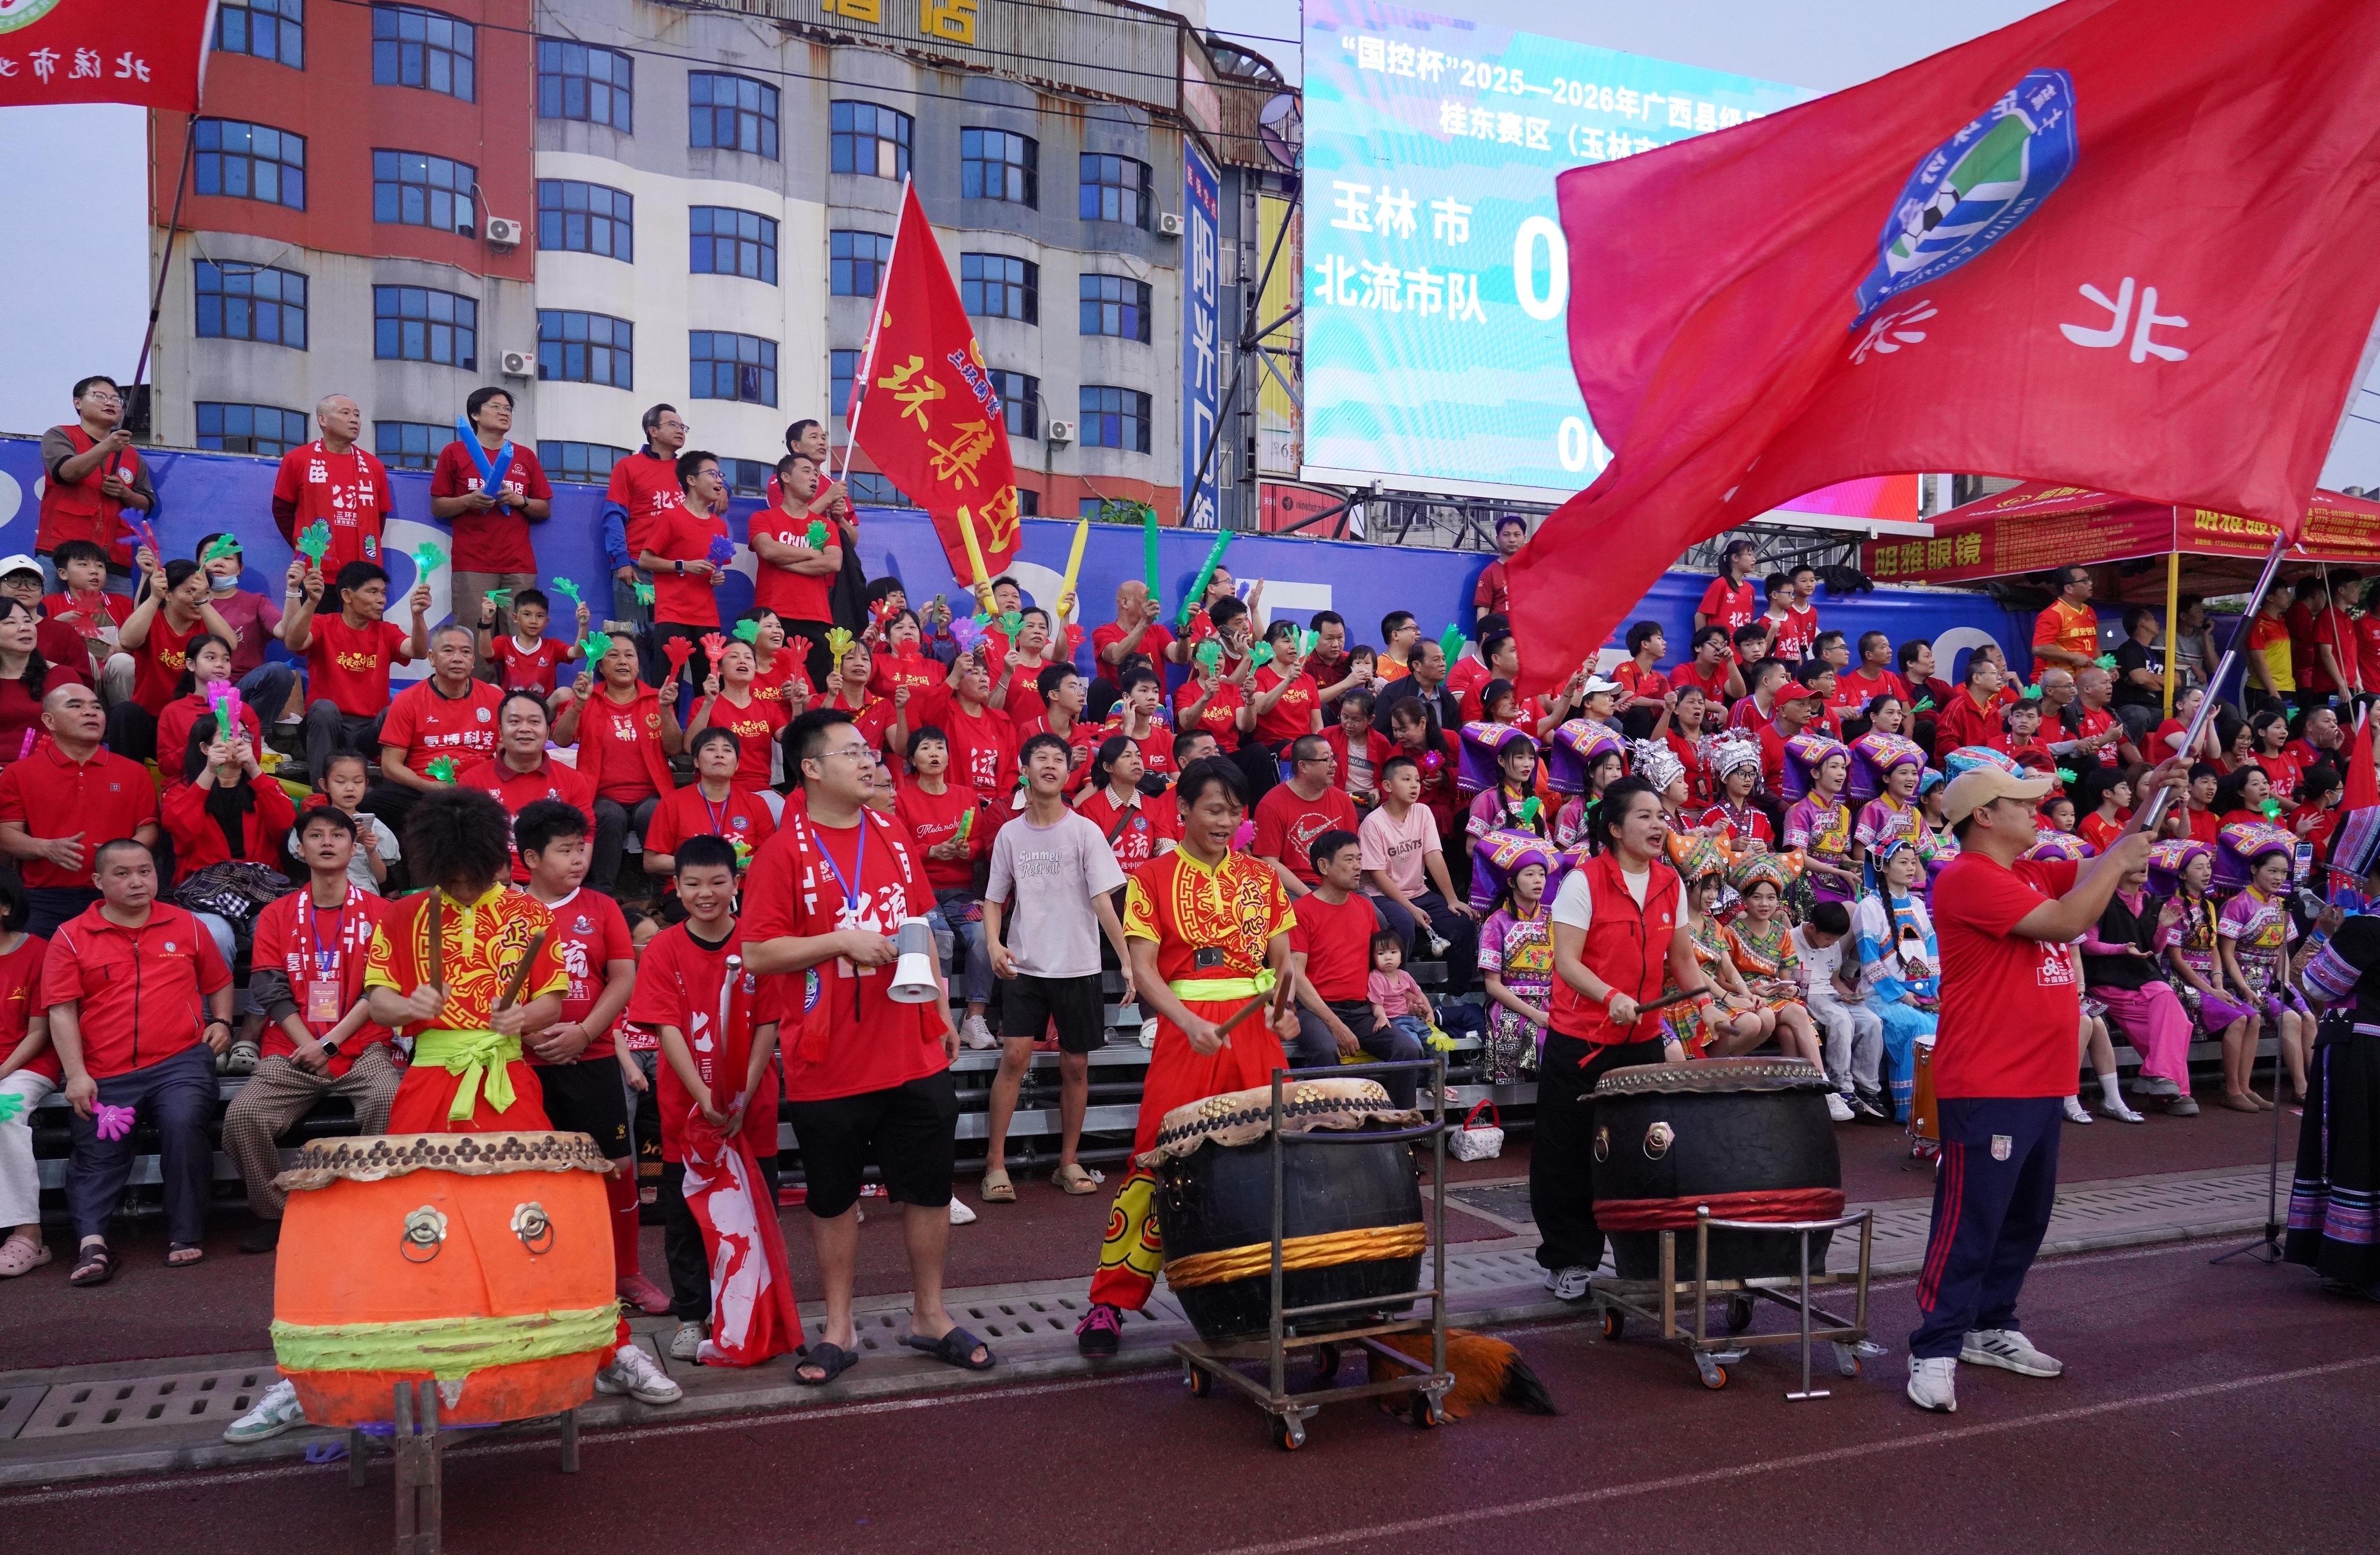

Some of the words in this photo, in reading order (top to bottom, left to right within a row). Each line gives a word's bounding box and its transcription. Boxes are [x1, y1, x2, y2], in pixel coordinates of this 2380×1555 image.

[1331, 181, 1417, 240] 玉林
[1432, 196, 1472, 247] 市
[1514, 216, 1568, 320] 0
[1314, 254, 1488, 325] 北流市队
[2195, 509, 2282, 536] 明雅眼
[779, 531, 814, 549] CHIN
[1874, 531, 1981, 577] 明雅眼镜
[2083, 639, 2092, 651] 12
[336, 651, 377, 669] 我爱你中国
[730, 720, 769, 737] 我爱你中国
[1388, 838, 1422, 857] GIANTS
[1018, 850, 1062, 866] Summer
[1022, 861, 1060, 879] Retreat
